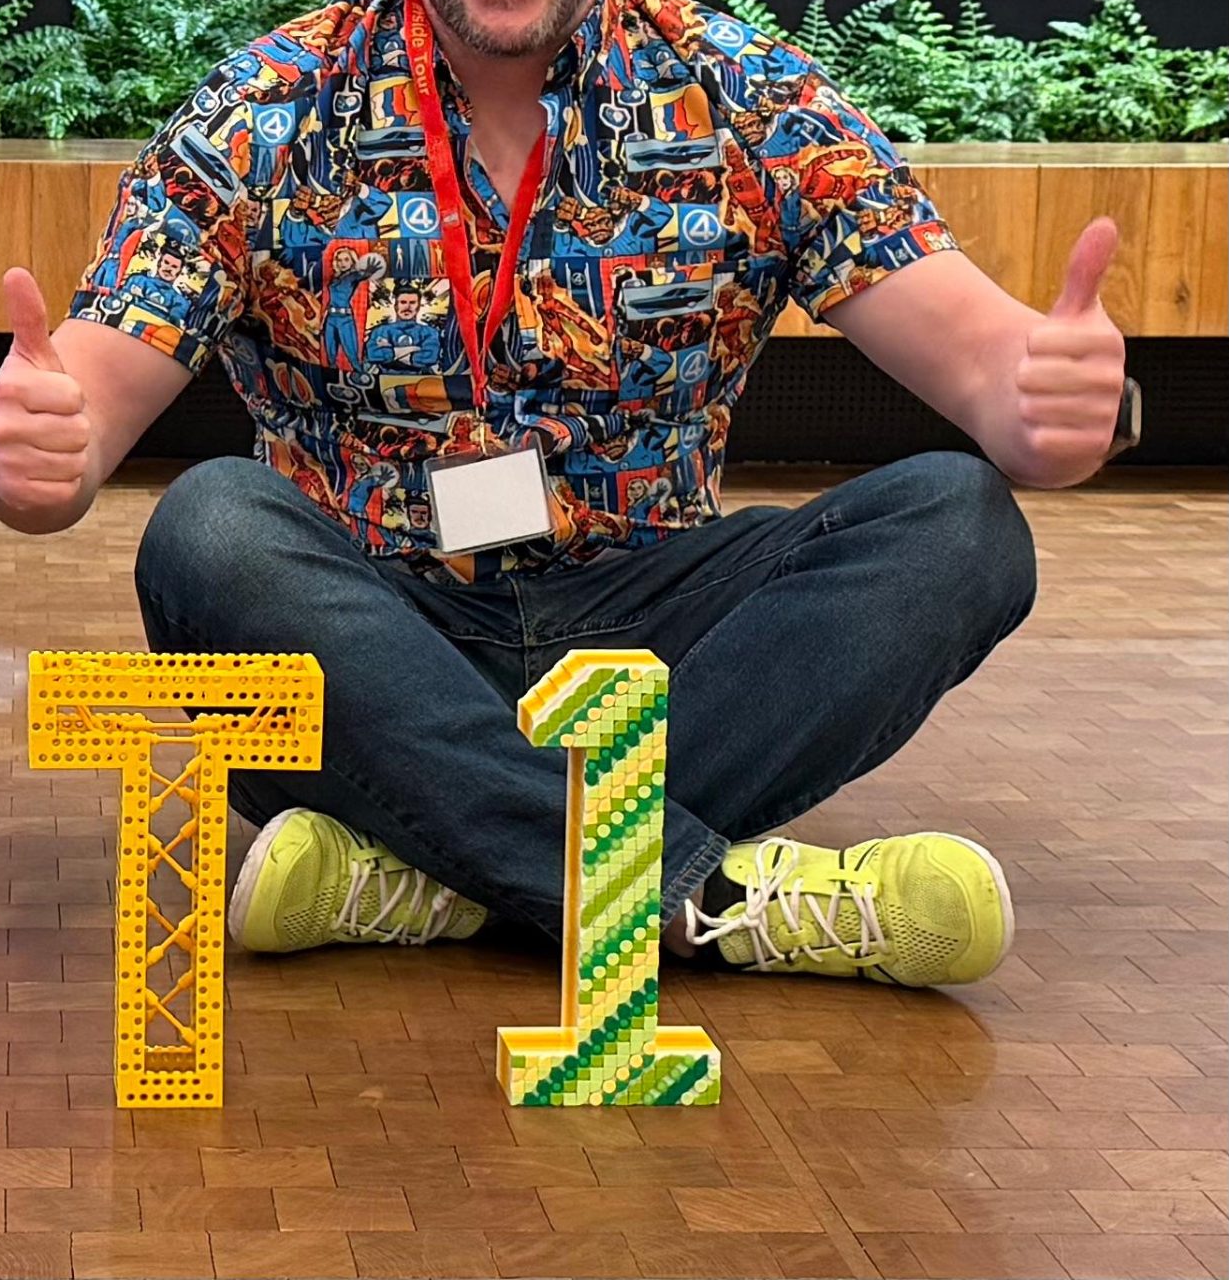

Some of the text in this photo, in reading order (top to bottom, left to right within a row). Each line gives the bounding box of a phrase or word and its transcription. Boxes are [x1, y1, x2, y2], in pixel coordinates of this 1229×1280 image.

[414, 52, 430, 96] Tour
[262, 112, 285, 138] 4
[409, 202, 433, 229] 4
[688, 213, 715, 241] 4
[684, 353, 702, 377] 4
